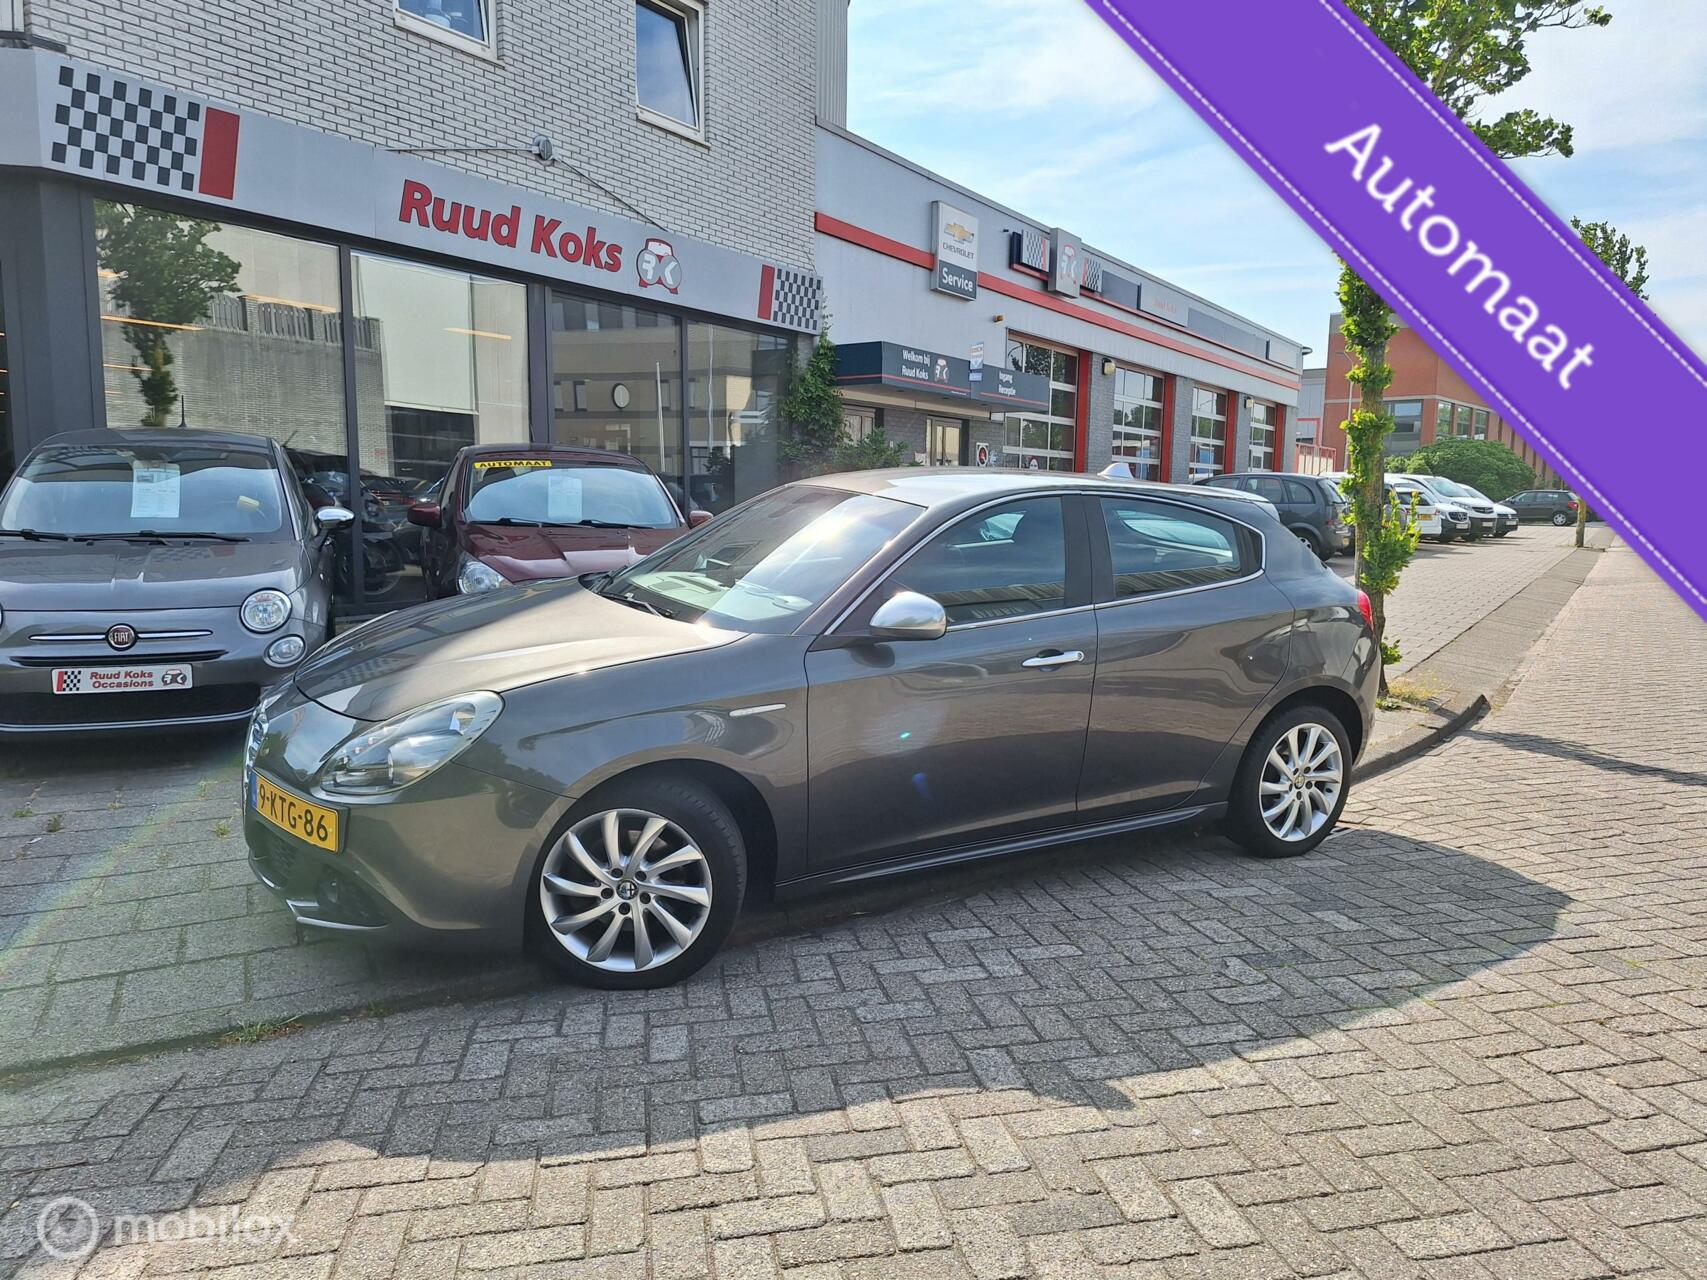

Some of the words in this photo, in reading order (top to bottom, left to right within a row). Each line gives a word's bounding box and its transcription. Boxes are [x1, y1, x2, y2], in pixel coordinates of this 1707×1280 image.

[399, 179, 521, 248] Ruud
[530, 214, 623, 273] Koks
[943, 243, 975, 260] CHEVROLET
[942, 267, 973, 292] Service
[902, 350, 923, 363] Welkom
[902, 365, 916, 378] Ruud
[916, 368, 929, 380] Koks
[114, 631, 129, 642] FIAT
[90, 671, 120, 680] Ruud
[123, 669, 153, 680] Koks
[92, 679, 154, 689] Occasions
[260, 783, 328, 841] 9-KTG-86
